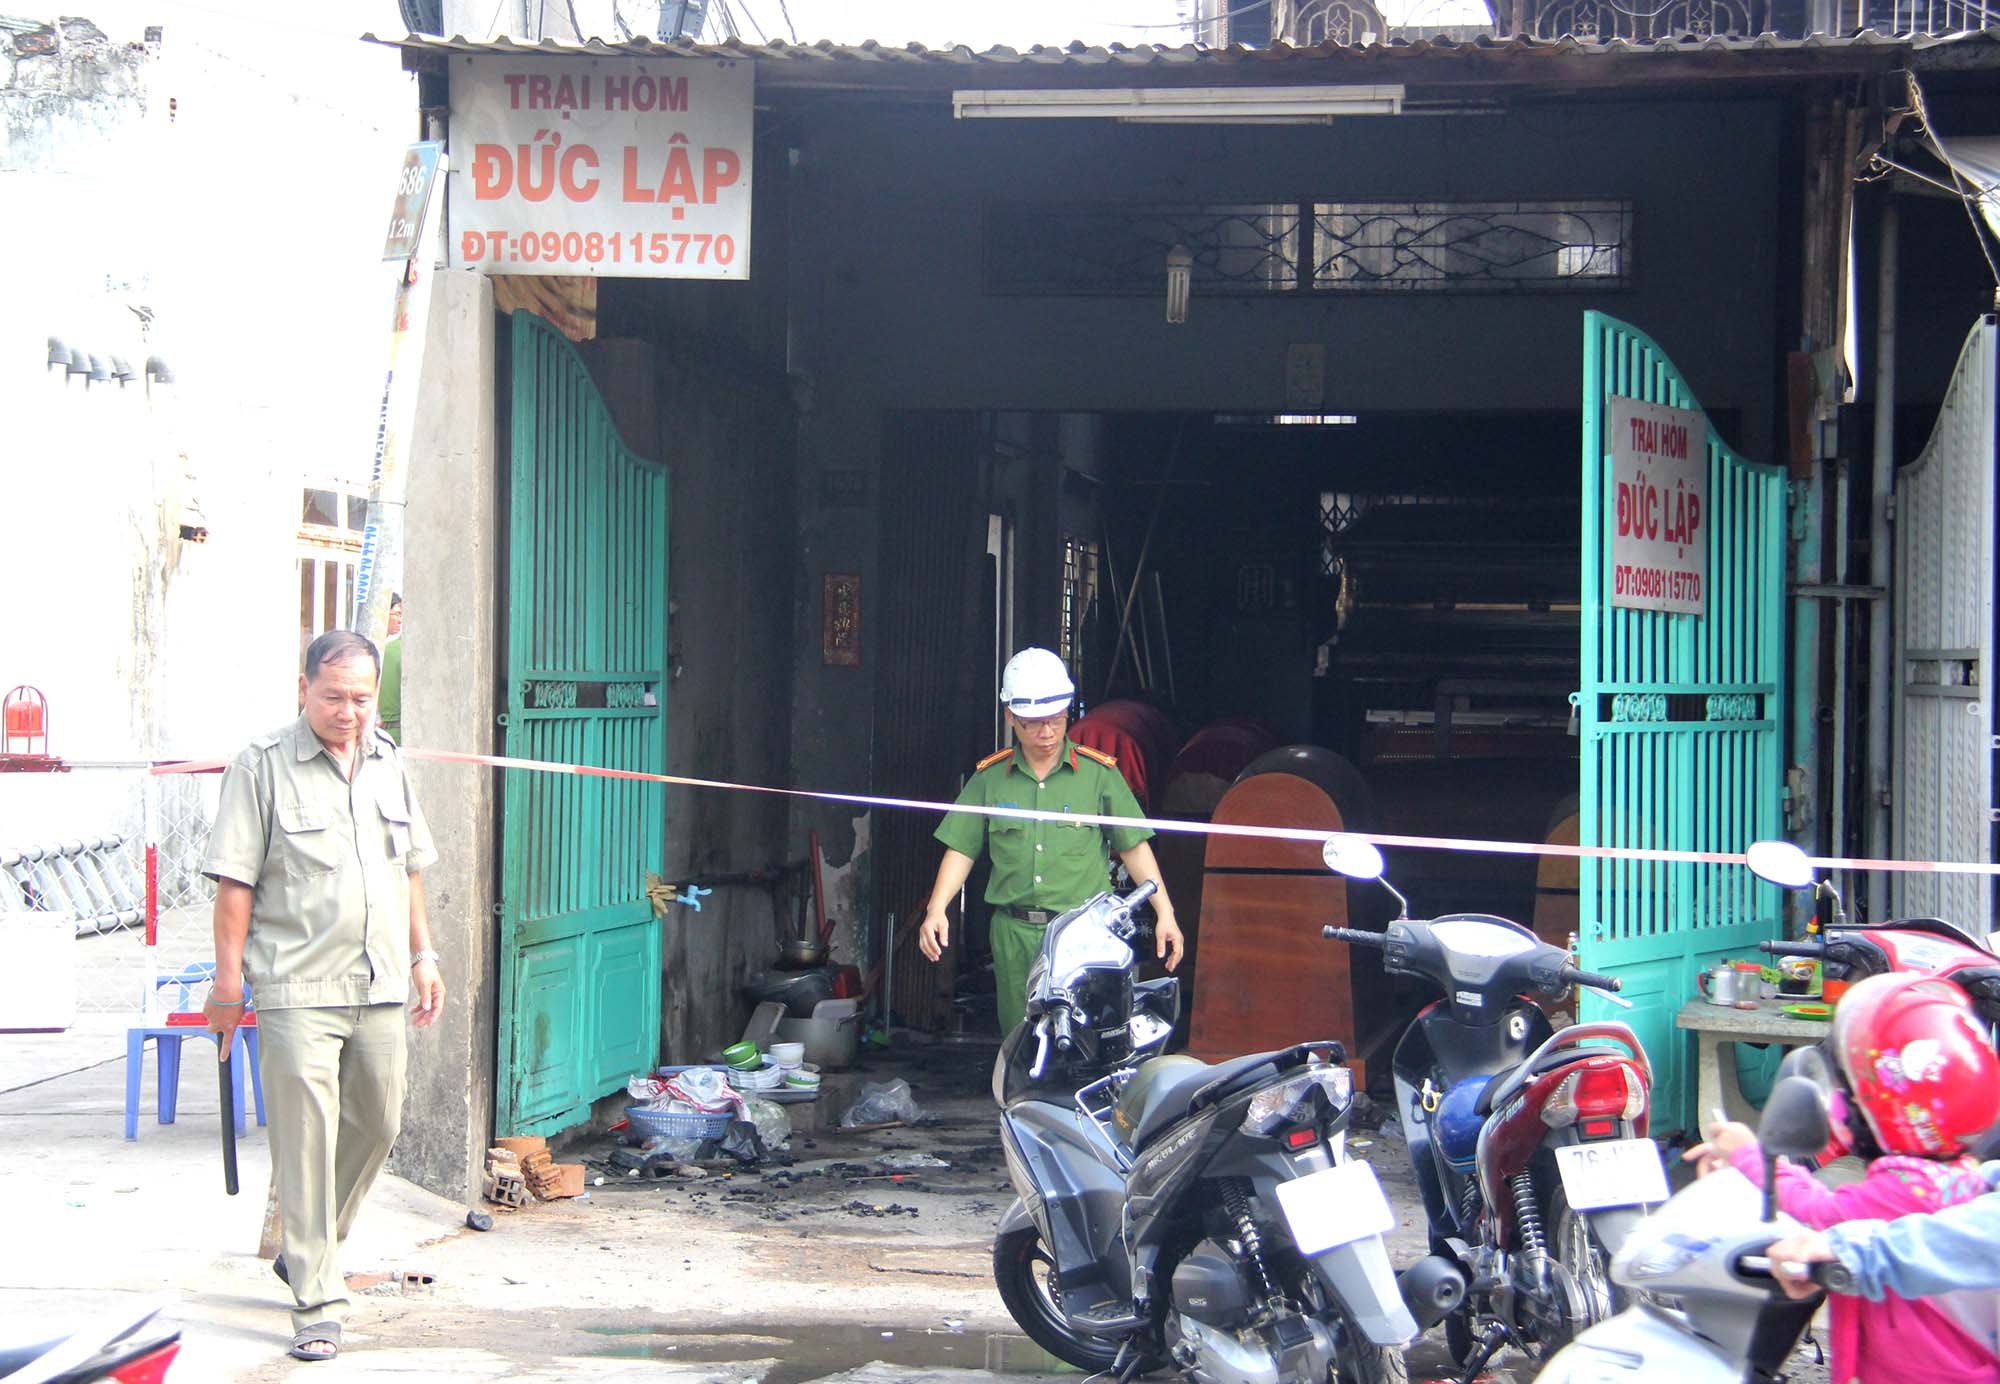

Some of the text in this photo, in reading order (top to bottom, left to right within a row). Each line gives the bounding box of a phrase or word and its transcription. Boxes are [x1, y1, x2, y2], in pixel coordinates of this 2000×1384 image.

[504, 66, 689, 119] TRẠI HÒM
[472, 129, 741, 220] ĐỨC LẬP
[461, 230, 735, 265] ĐT:0908115770
[1630, 416, 1687, 464] TRẠI HÒM
[1617, 470, 1700, 559] ĐỨC LẬP
[1615, 565, 1700, 603] ĐT:0908115770
